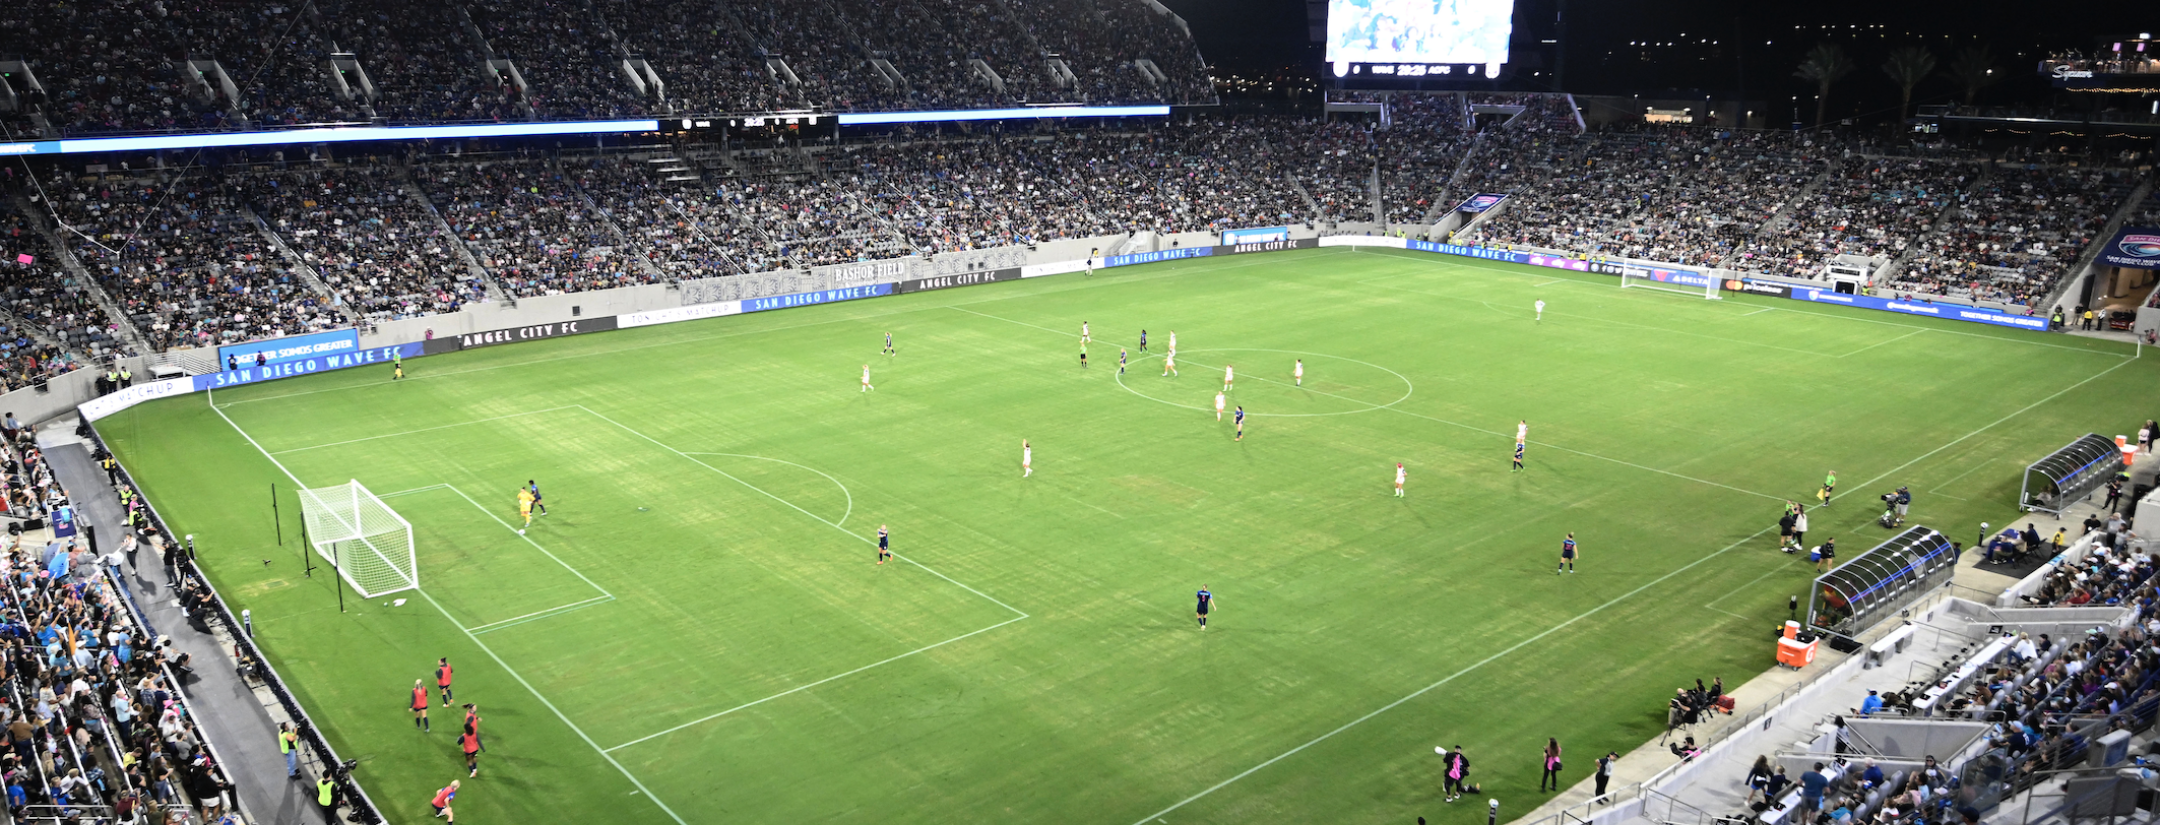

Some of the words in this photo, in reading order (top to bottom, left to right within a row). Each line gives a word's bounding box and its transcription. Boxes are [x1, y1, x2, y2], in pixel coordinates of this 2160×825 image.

[1234, 241, 1262, 253] ANGEL
[1265, 240, 1284, 250] CITY
[1287, 240, 1298, 248] FC
[1416, 241, 1433, 251] SAN
[1439, 244, 1467, 255] DIEGO
[1472, 248, 1500, 260] WAVE
[1504, 252, 1516, 262] FC
[1113, 255, 1130, 265] SAN
[1134, 252, 1159, 263] DIEGO
[1162, 249, 1186, 260] WAVE
[835, 265, 875, 281] BASHOR
[877, 262, 904, 277] FIELD
[919, 276, 953, 290] ANGEL
[957, 273, 979, 284] CITY
[984, 271, 996, 281] FC
[755, 297, 778, 310] SAN
[785, 293, 820, 306] DIEGO
[827, 288, 860, 301] WAVE
[865, 285, 878, 296] FC
[463, 329, 512, 346] ANGEL
[520, 324, 554, 338] CITY
[561, 321, 578, 334] FC
[279, 344, 312, 358] SOMOS
[313, 339, 353, 352] GREATER
[216, 369, 252, 386] SAN
[262, 359, 317, 378] DIEGO
[326, 350, 375, 368] WAVE
[1805, 645, 1815, 663] G
